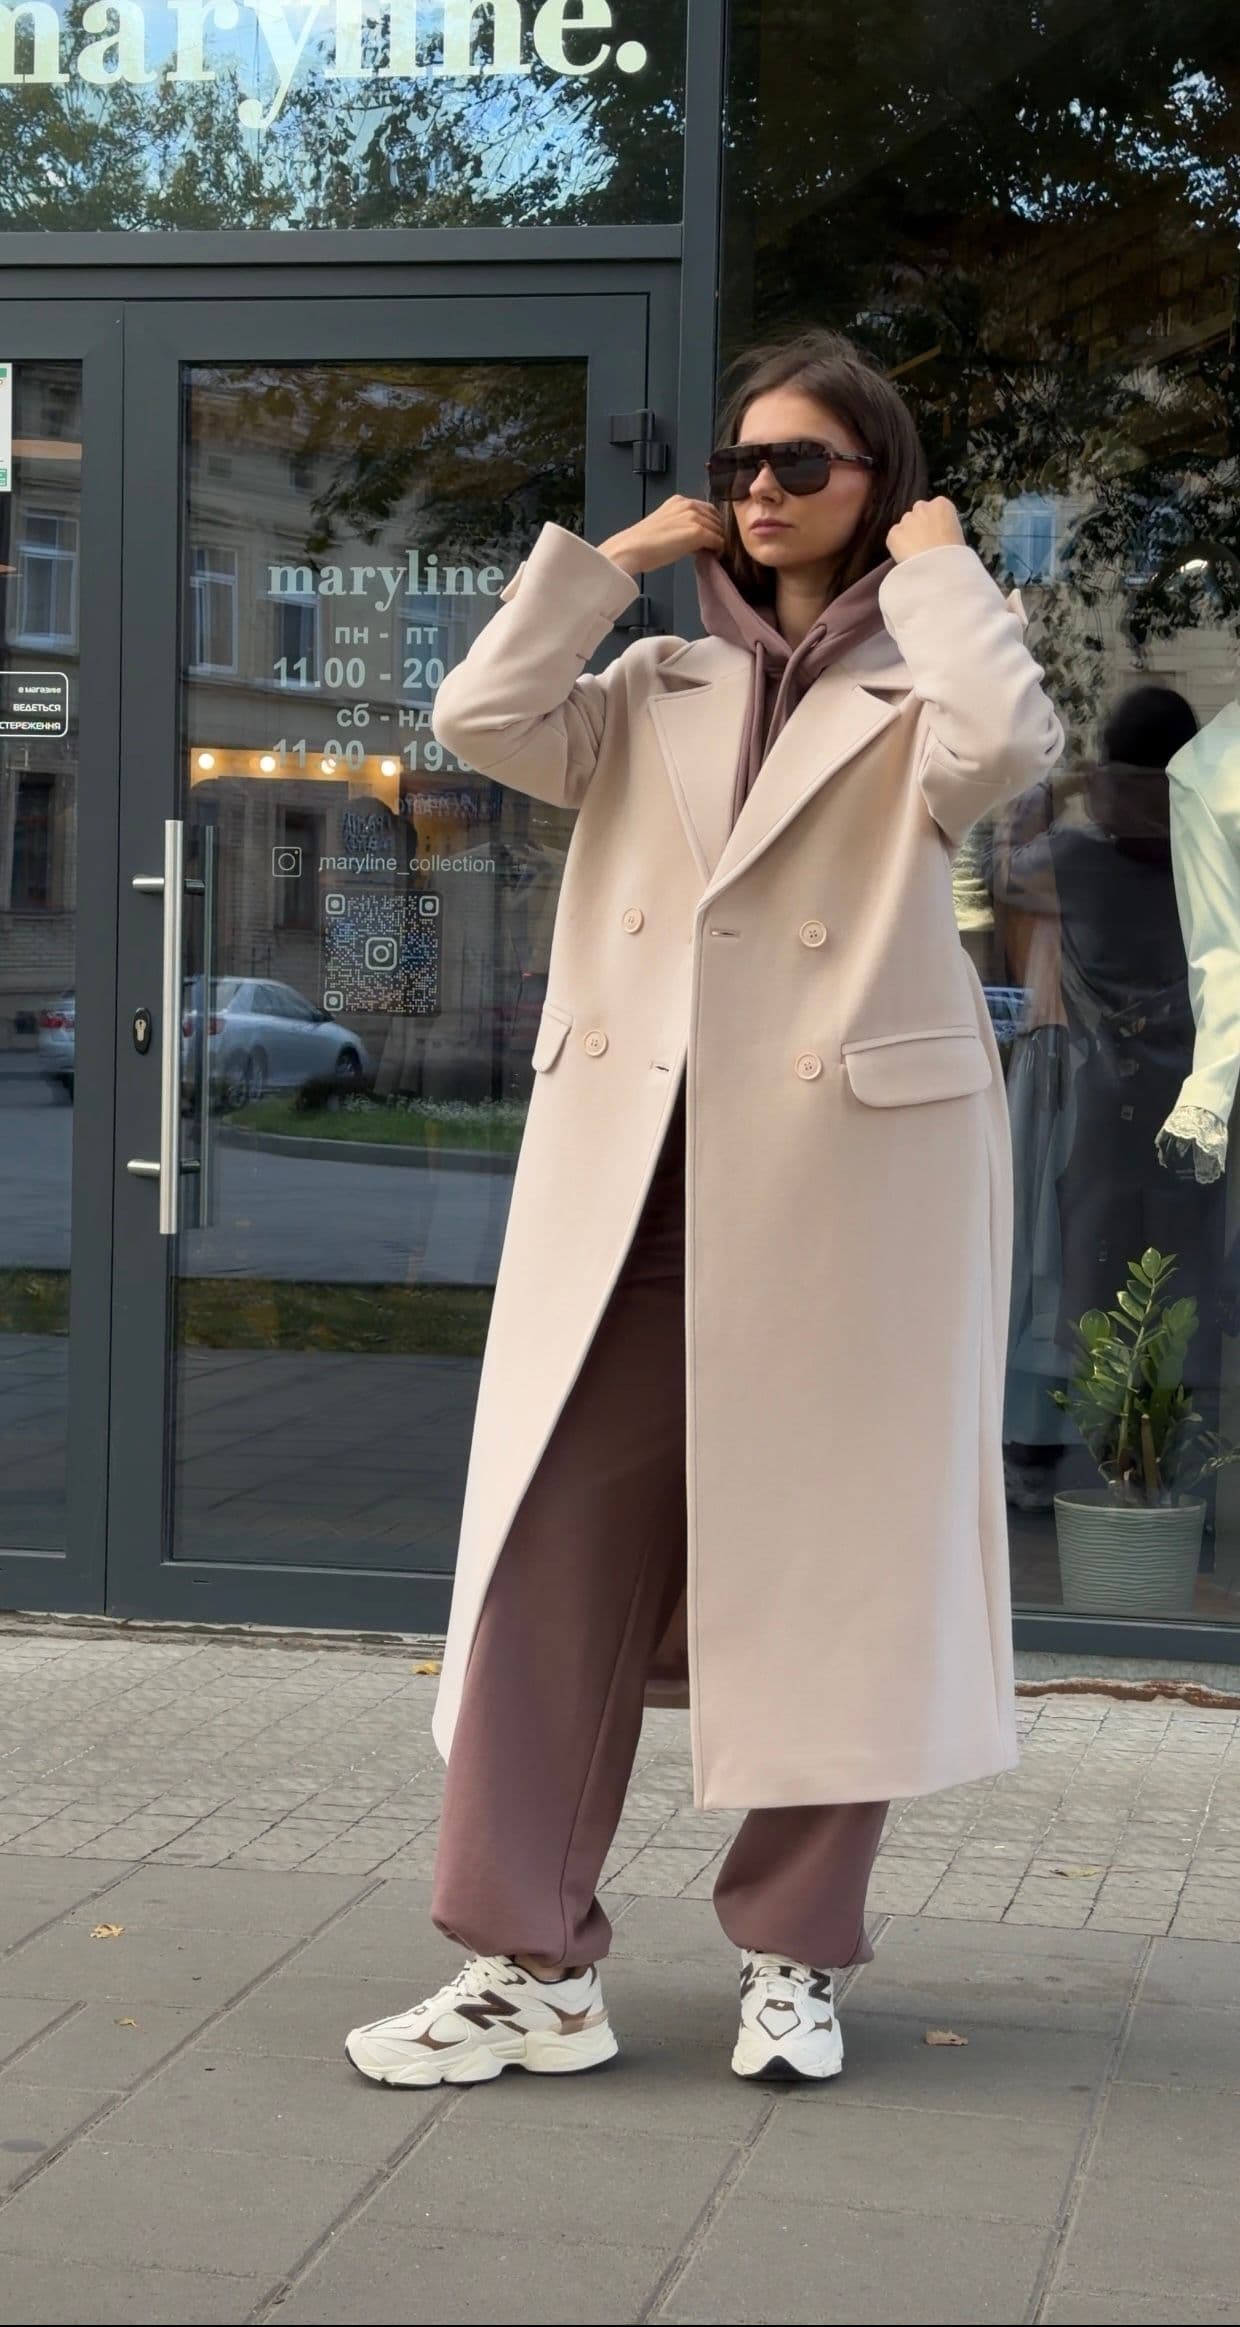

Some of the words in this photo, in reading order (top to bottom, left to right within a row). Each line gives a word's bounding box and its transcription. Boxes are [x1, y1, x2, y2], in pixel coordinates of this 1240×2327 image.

[267, 549, 504, 612] maryline
[335, 627, 369, 644] пн
[406, 627, 438, 644] пт
[273, 656, 366, 688] 11.00
[13, 703, 61, 712] ВЕДЕТЬСЯ
[336, 703, 370, 727] сб
[272, 739, 366, 771] 1100
[319, 853, 496, 876] maryline_collection
